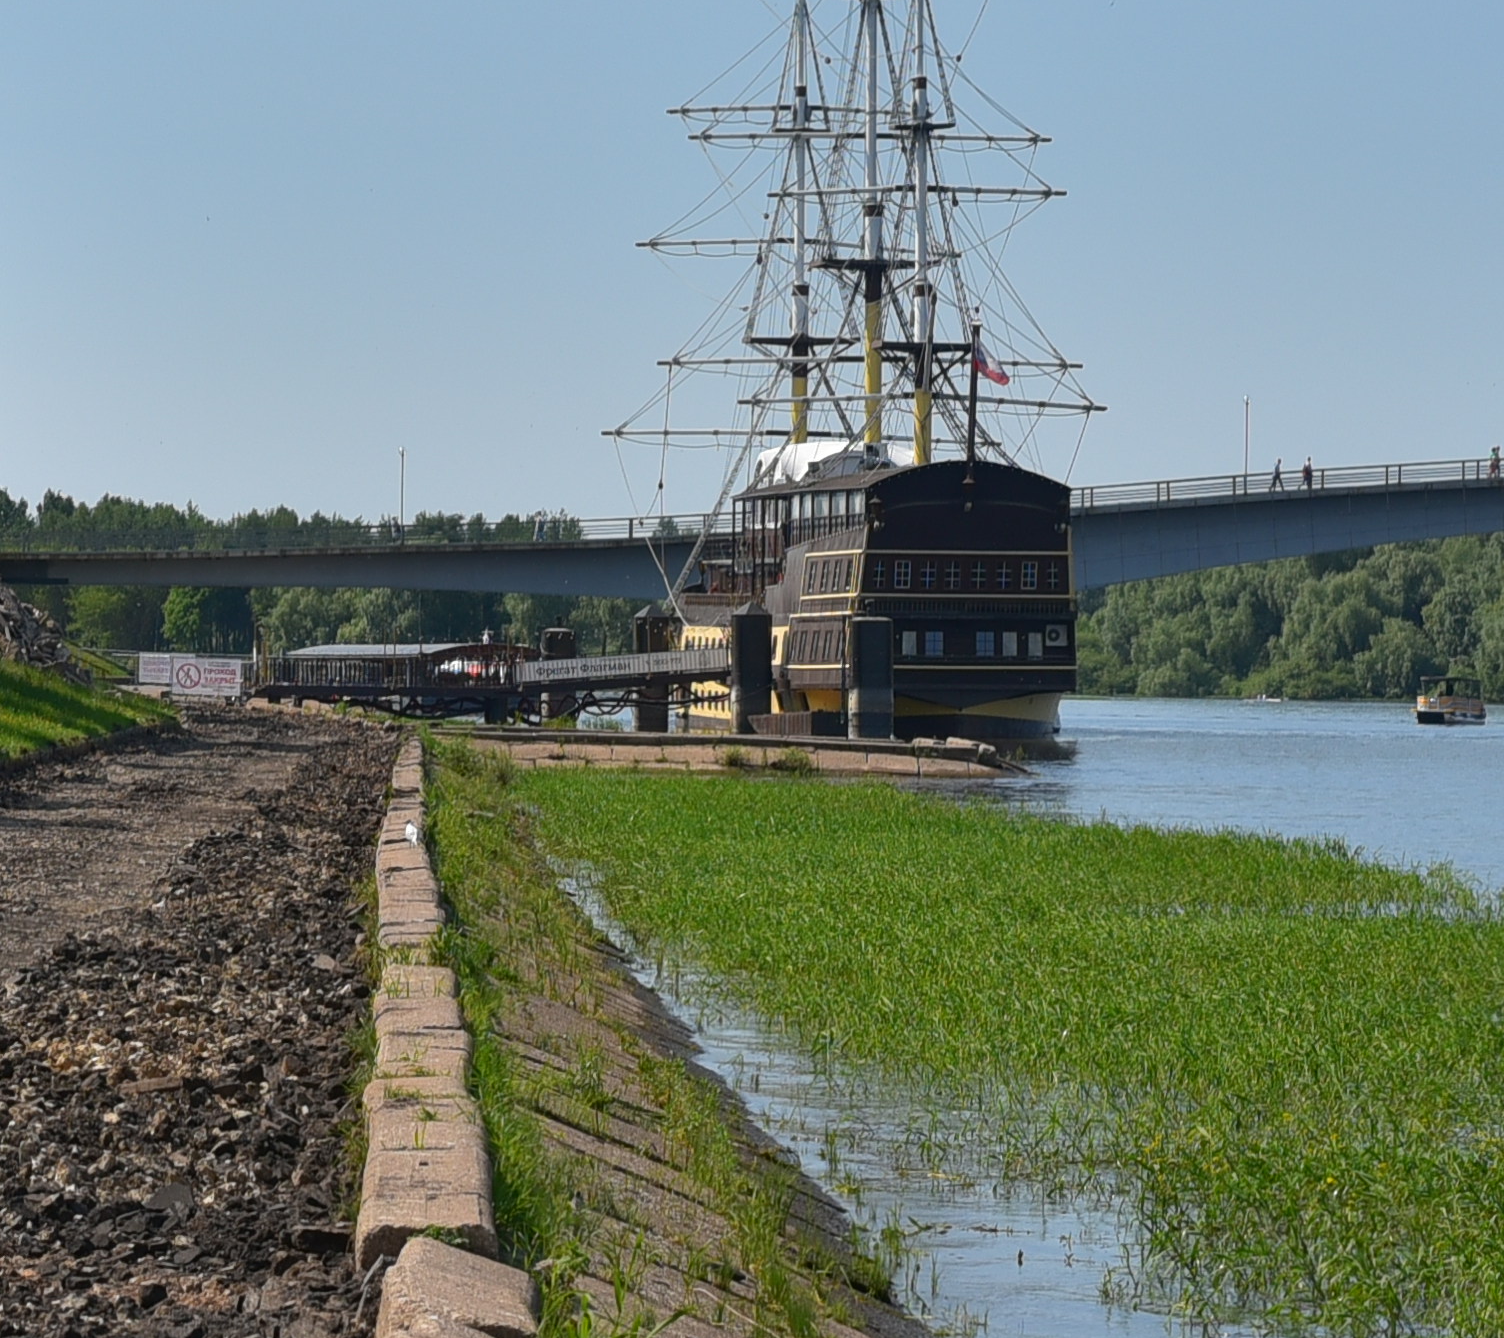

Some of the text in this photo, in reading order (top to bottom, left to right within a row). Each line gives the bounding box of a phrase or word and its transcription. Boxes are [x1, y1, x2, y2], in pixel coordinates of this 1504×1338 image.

[203, 668, 237, 676] ПРОХОД
[536, 661, 631, 677] Фрегат Флагман
